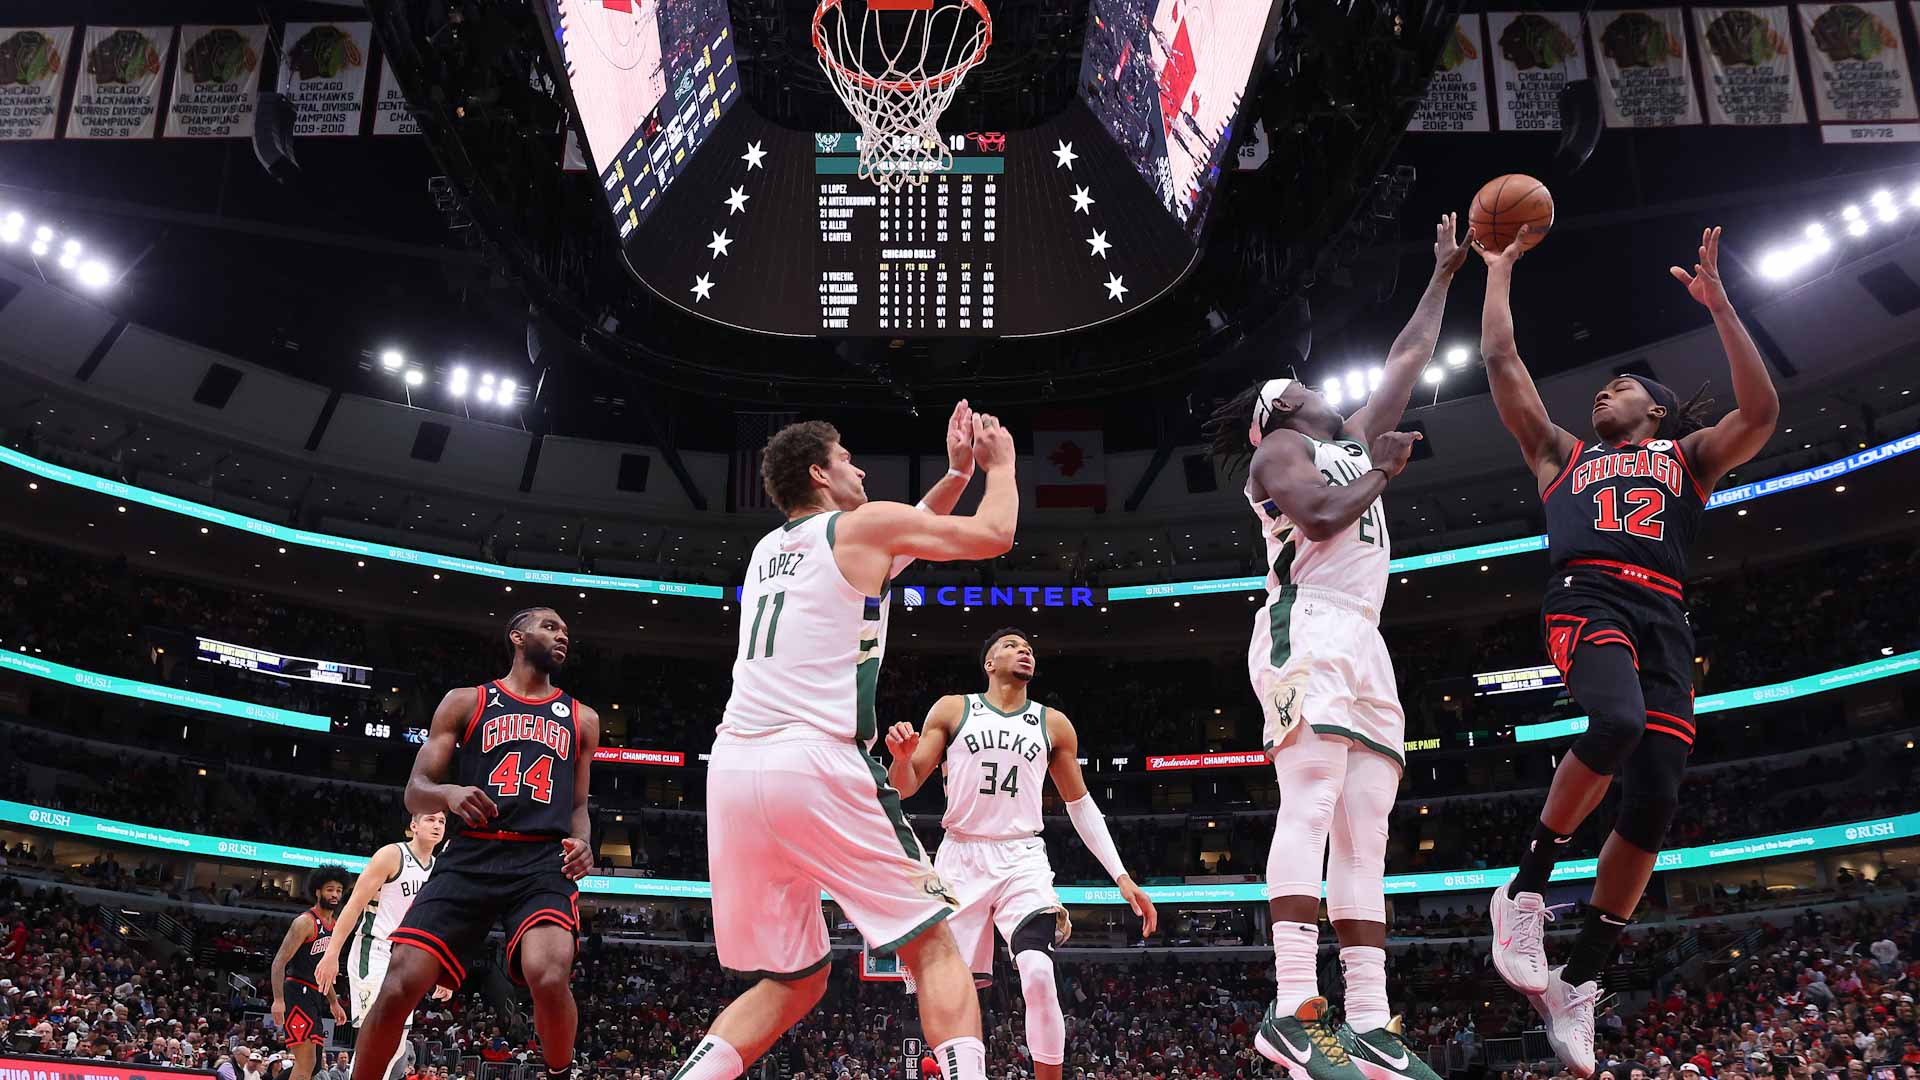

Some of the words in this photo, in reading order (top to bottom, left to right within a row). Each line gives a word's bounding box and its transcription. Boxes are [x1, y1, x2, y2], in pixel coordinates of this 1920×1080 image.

[1433, 73, 1462, 82] CAGO
[1518, 73, 1564, 81] CHICAGO
[96, 86, 140, 95] CHICAGO
[194, 84, 238, 93] CHICAGO
[299, 82, 343, 91] CHICAGO
[1432, 83, 1477, 91] KHAWKS
[82, 96, 151, 105] BLACKHAWKS
[180, 94, 248, 103] BLACKHAWKS
[1431, 92, 1468, 101] STERN
[75, 106, 109, 115] NORRIS
[112, 106, 154, 115] DIVISION
[173, 104, 209, 114] NORRIS
[211, 104, 253, 113] DIVISION
[295, 103, 319, 112] TRAL
[322, 102, 361, 112] DIVISION
[1508, 101, 1560, 110] CONFERE
[181, 115, 239, 124] CHAMPIONS
[1411, 111, 1474, 121] CHAMPIONS
[1514, 111, 1561, 120] CHAMPIO
[82, 117, 141, 126] CHAMPIONS
[1422, 121, 1464, 130] 2012-13
[1516, 120, 1561, 129] 2009-2
[294, 124, 345, 133] 009-2010
[949, 135, 965, 151] 10
[828, 184, 848, 194] LOPEZ
[818, 196, 827, 206] 34
[820, 208, 828, 218] 21
[828, 208, 854, 218] HOLIDAY
[820, 220, 828, 230] 12
[828, 220, 848, 230] ALLEN
[828, 232, 852, 242] CARTER
[882, 249, 913, 259] CHICAGO
[914, 249, 936, 259] BULLS
[985, 263, 992, 271] FT
[828, 272, 854, 281] VUCEVIC
[818, 284, 828, 293] 44
[828, 284, 858, 293] WILLIAMS
[820, 295, 828, 305] 12
[828, 307, 850, 317] LAVINE
[828, 319, 848, 328] WHITE
[1572, 450, 1683, 497] CHICAGO
[1755, 461, 1847, 495] LEGENDS
[1709, 486, 1752, 506] LIGHT
[1593, 486, 1666, 541] 12
[1359, 505, 1384, 548] 21
[397, 550, 418, 561] RUSH
[1432, 553, 1456, 563] RUSH
[759, 553, 804, 584] LOPEZ
[532, 572, 553, 581] RUSH
[666, 584, 687, 593] RUSH
[1152, 586, 1174, 594] RUSH
[936, 586, 1093, 607] CENTER
[746, 591, 785, 660] 11
[1763, 685, 1796, 699] RUSH
[365, 722, 391, 739] 6:55
[482, 713, 571, 762] CHICAGO
[964, 730, 1042, 762] BUCKS
[1404, 741, 1418, 752] THE
[1419, 738, 1441, 750] PAINT
[622, 752, 662, 762] CHAMPIONS
[662, 754, 680, 763] CLUB
[1112, 757, 1128, 766] FOULS
[1150, 757, 1200, 769] Budweiser
[1203, 755, 1245, 765] CHAMPIONS
[1246, 754, 1265, 763] CLUB
[488, 751, 555, 805] 44
[979, 761, 1019, 798] 34
[40, 812, 71, 826] RUSH
[96, 823, 129, 836] Excellence
[135, 831, 147, 839] just
[147, 832, 158, 841] the
[1857, 822, 1895, 839] RUSH
[228, 842, 257, 856] RUSH
[1709, 848, 1744, 858] Excellence
[1751, 844, 1765, 854] just
[1765, 842, 1777, 850] the
[282, 851, 314, 862] Excellence
[319, 856, 332, 865] just
[1657, 854, 1682, 865] USH
[583, 879, 610, 889] RUSH
[1455, 874, 1485, 885] RUSH
[1094, 890, 1120, 900] RUSH
[905, 1057, 918, 1069] GET
[905, 1069, 918, 1080] THE
